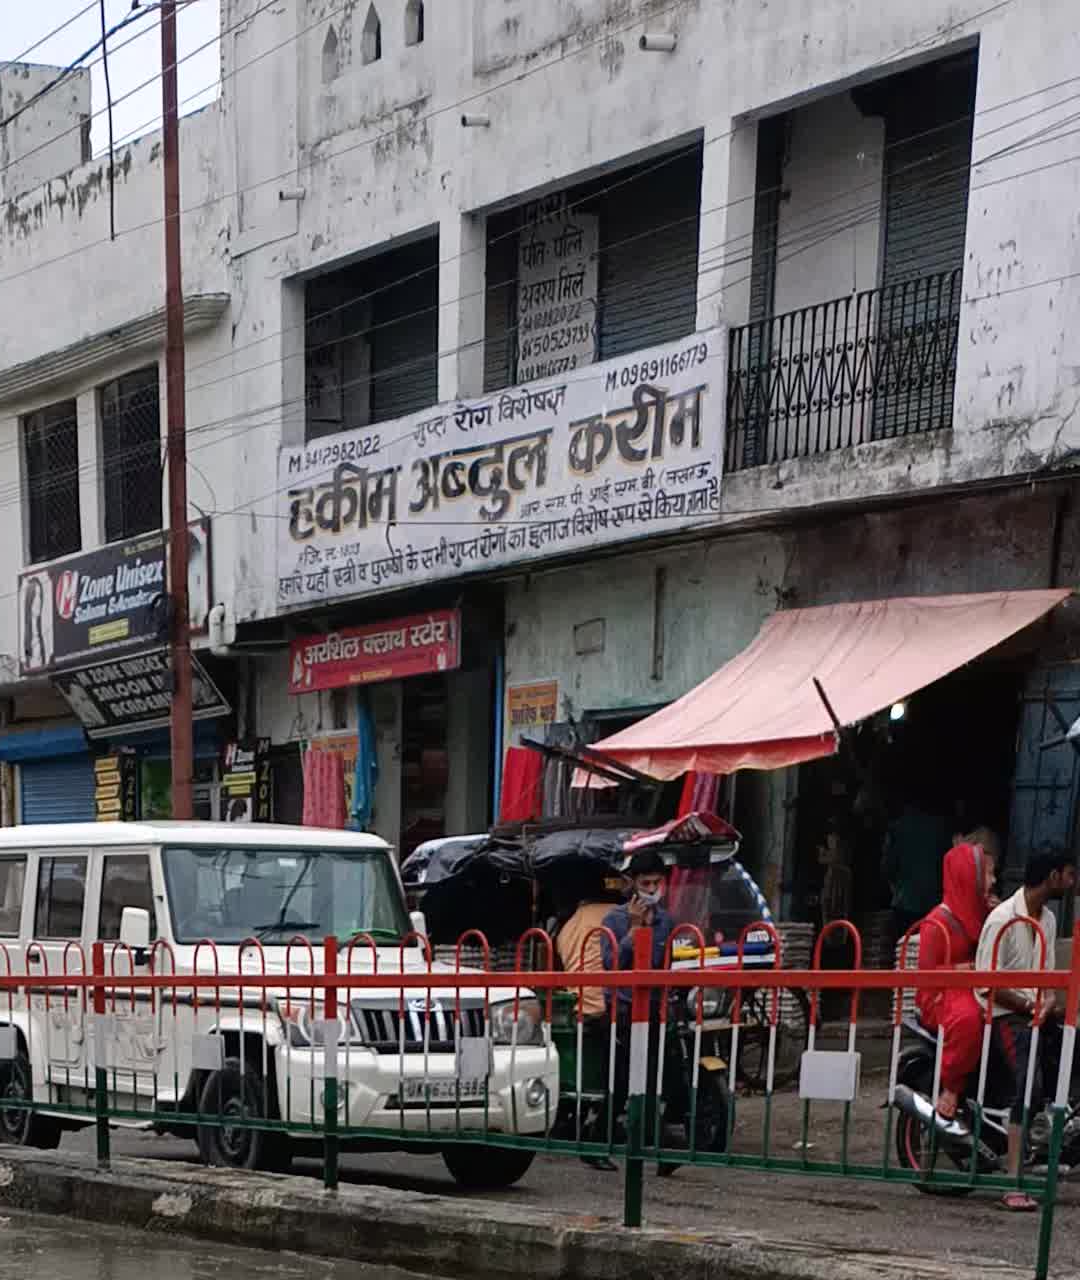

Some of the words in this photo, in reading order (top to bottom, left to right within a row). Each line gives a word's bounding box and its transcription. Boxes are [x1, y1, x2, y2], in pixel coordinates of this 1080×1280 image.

[413, 416, 447, 447] गुप्त
[455, 403, 493, 432] रोग
[288, 463, 403, 542] हकीम
[409, 427, 555, 521] अब्दुल
[569, 383, 707, 474] करीम
[405, 544, 420, 572] के
[421, 535, 450, 569] सभी
[56, 569, 78, 621] M
[80, 572, 113, 604] Zone
[116, 557, 164, 594] Unisex
[410, 617, 448, 647] स्टोर
[90, 663, 123, 685] ZONE
